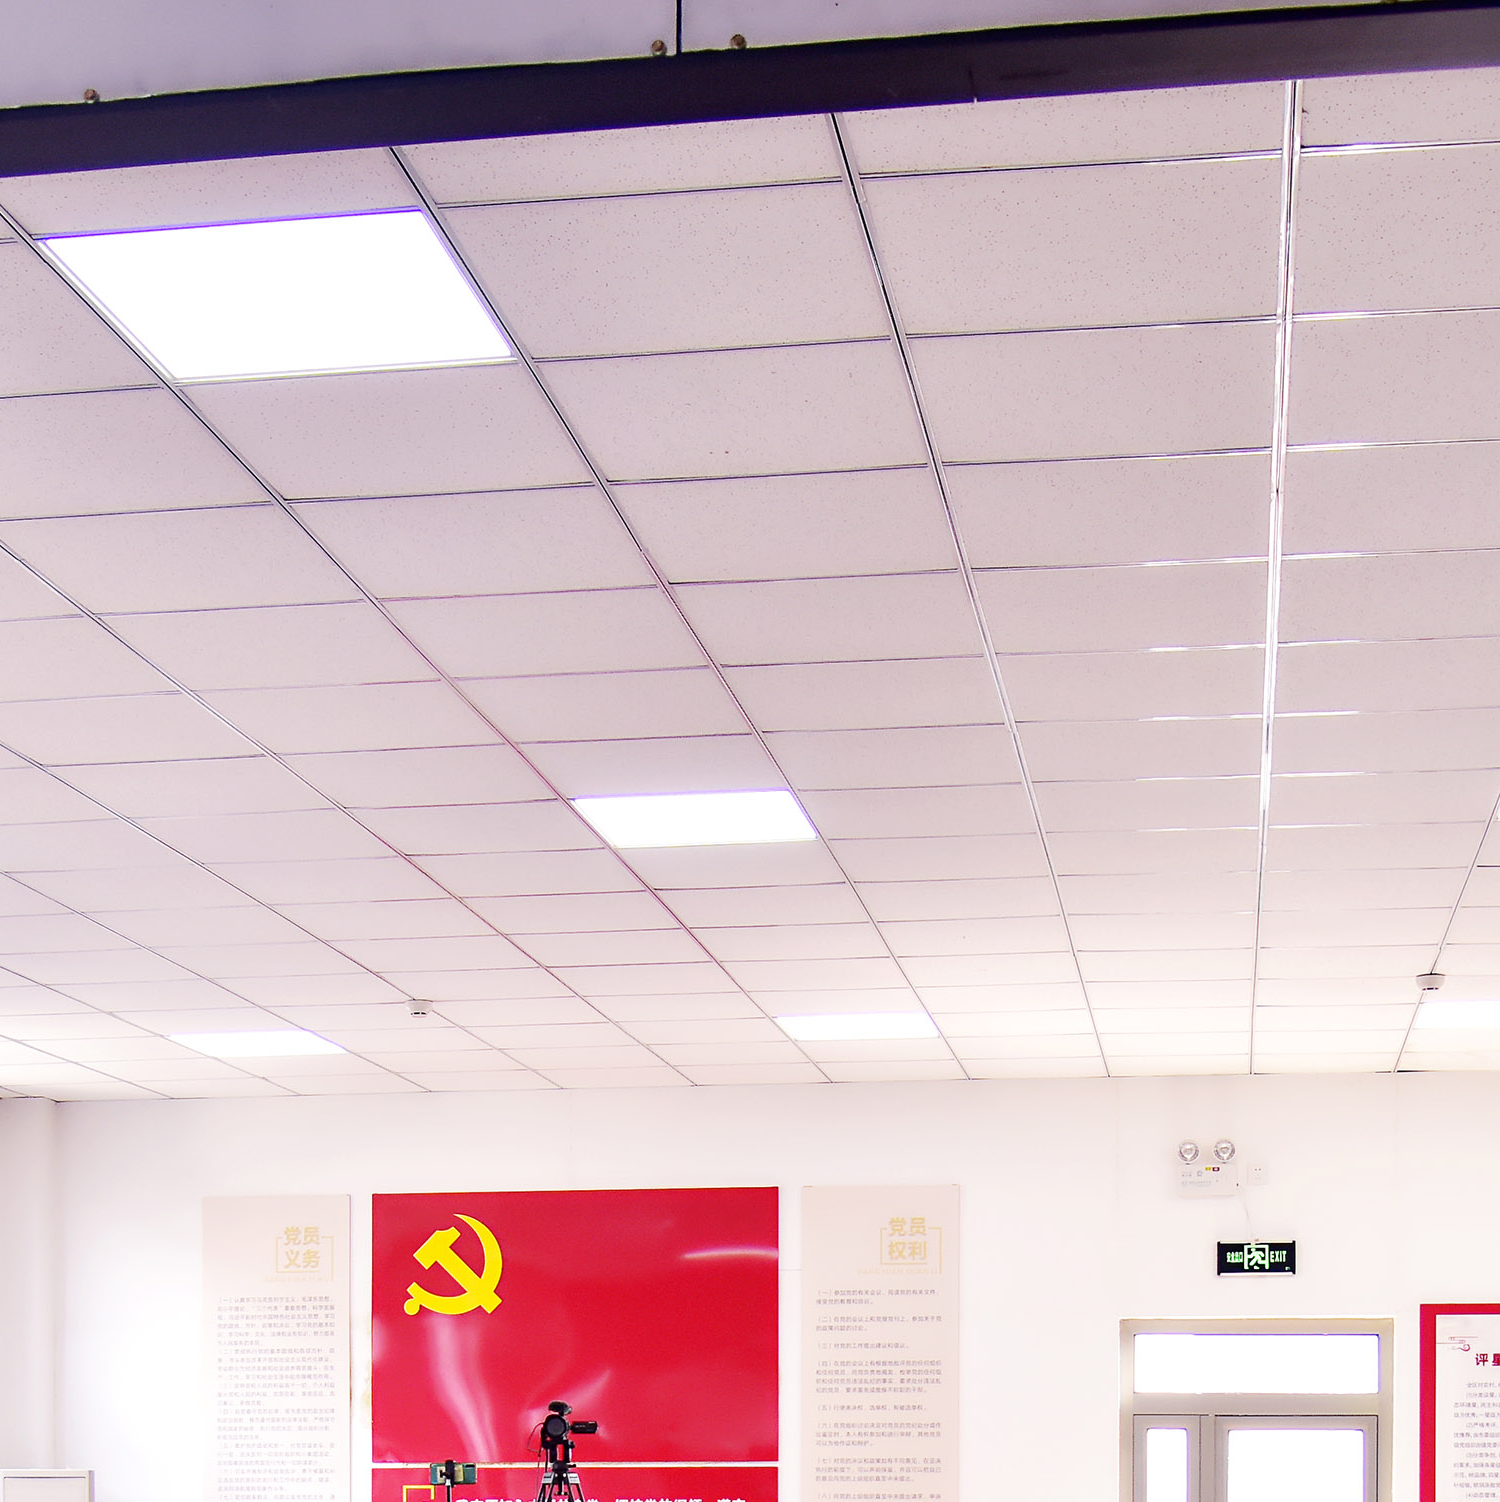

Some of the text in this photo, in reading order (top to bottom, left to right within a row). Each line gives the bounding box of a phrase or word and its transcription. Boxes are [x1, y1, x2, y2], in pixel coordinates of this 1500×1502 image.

[284, 1226, 320, 1246] 党员
[888, 1217, 927, 1237] 党员
[284, 1249, 320, 1269] 义务
[888, 1241, 927, 1261] 权利
[1270, 1250, 1287, 1263] EXIT
